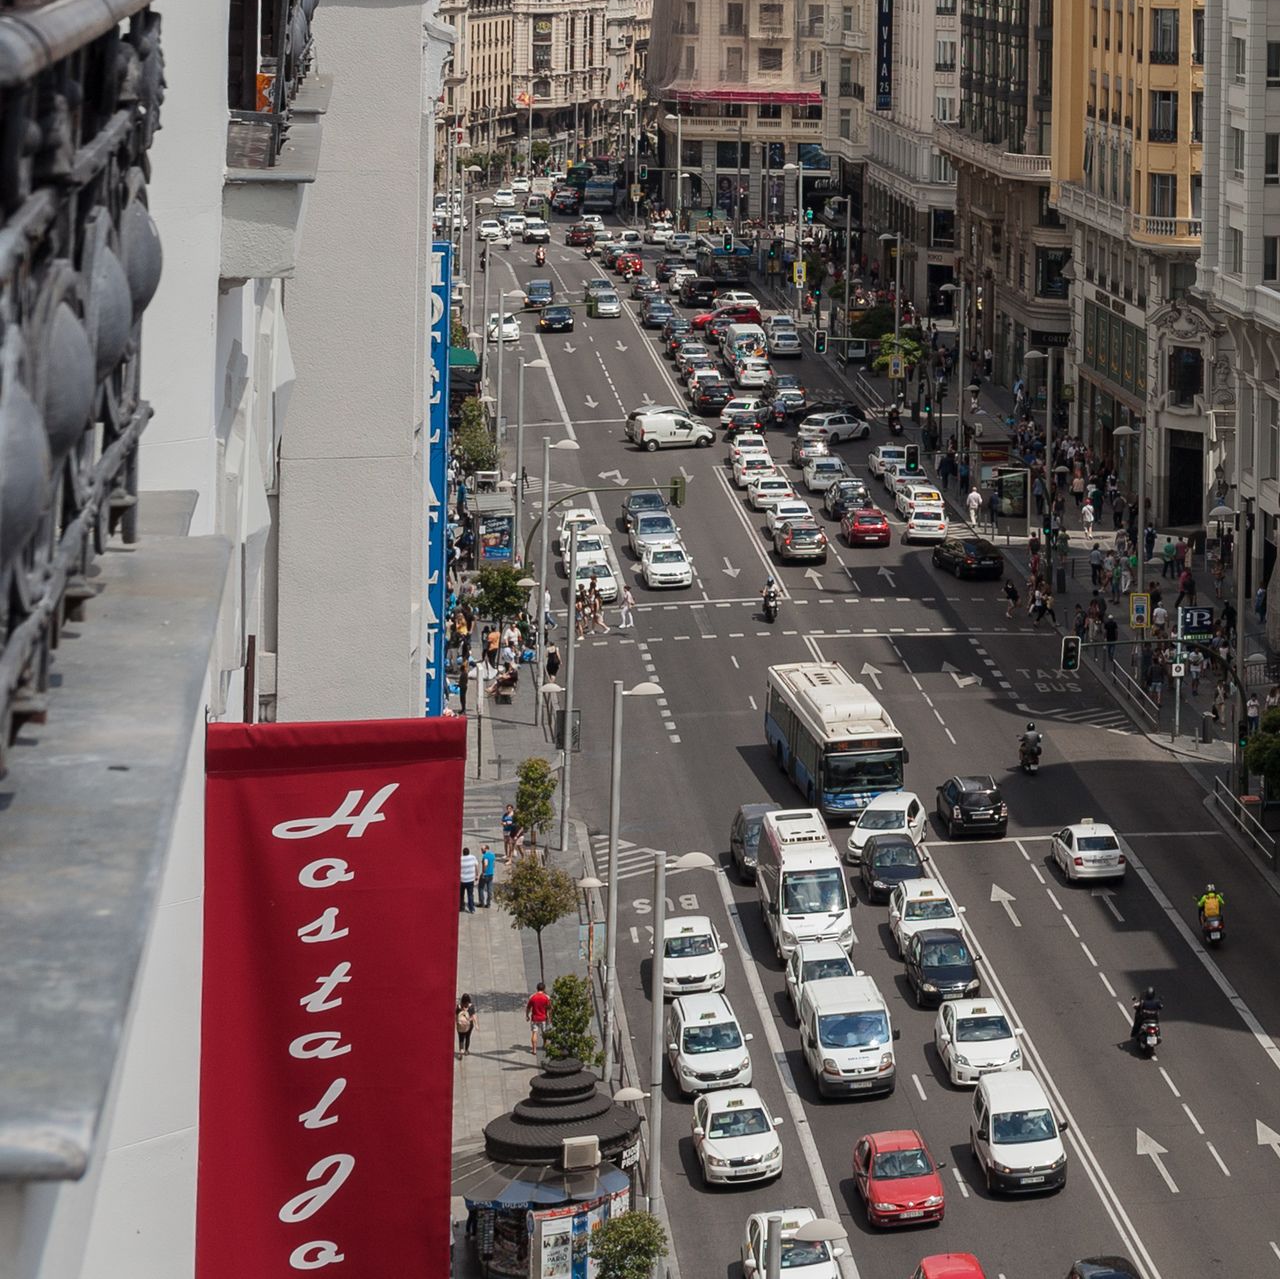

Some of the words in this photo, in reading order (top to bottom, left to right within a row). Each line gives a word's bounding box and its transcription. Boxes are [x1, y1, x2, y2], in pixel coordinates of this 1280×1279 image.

[881, 26, 889, 77] VÍA
[879, 82, 890, 92] 25
[1016, 669, 1080, 679] TAXI
[1035, 682, 1082, 692] BUS
[272, 783, 399, 1129] Hostal
